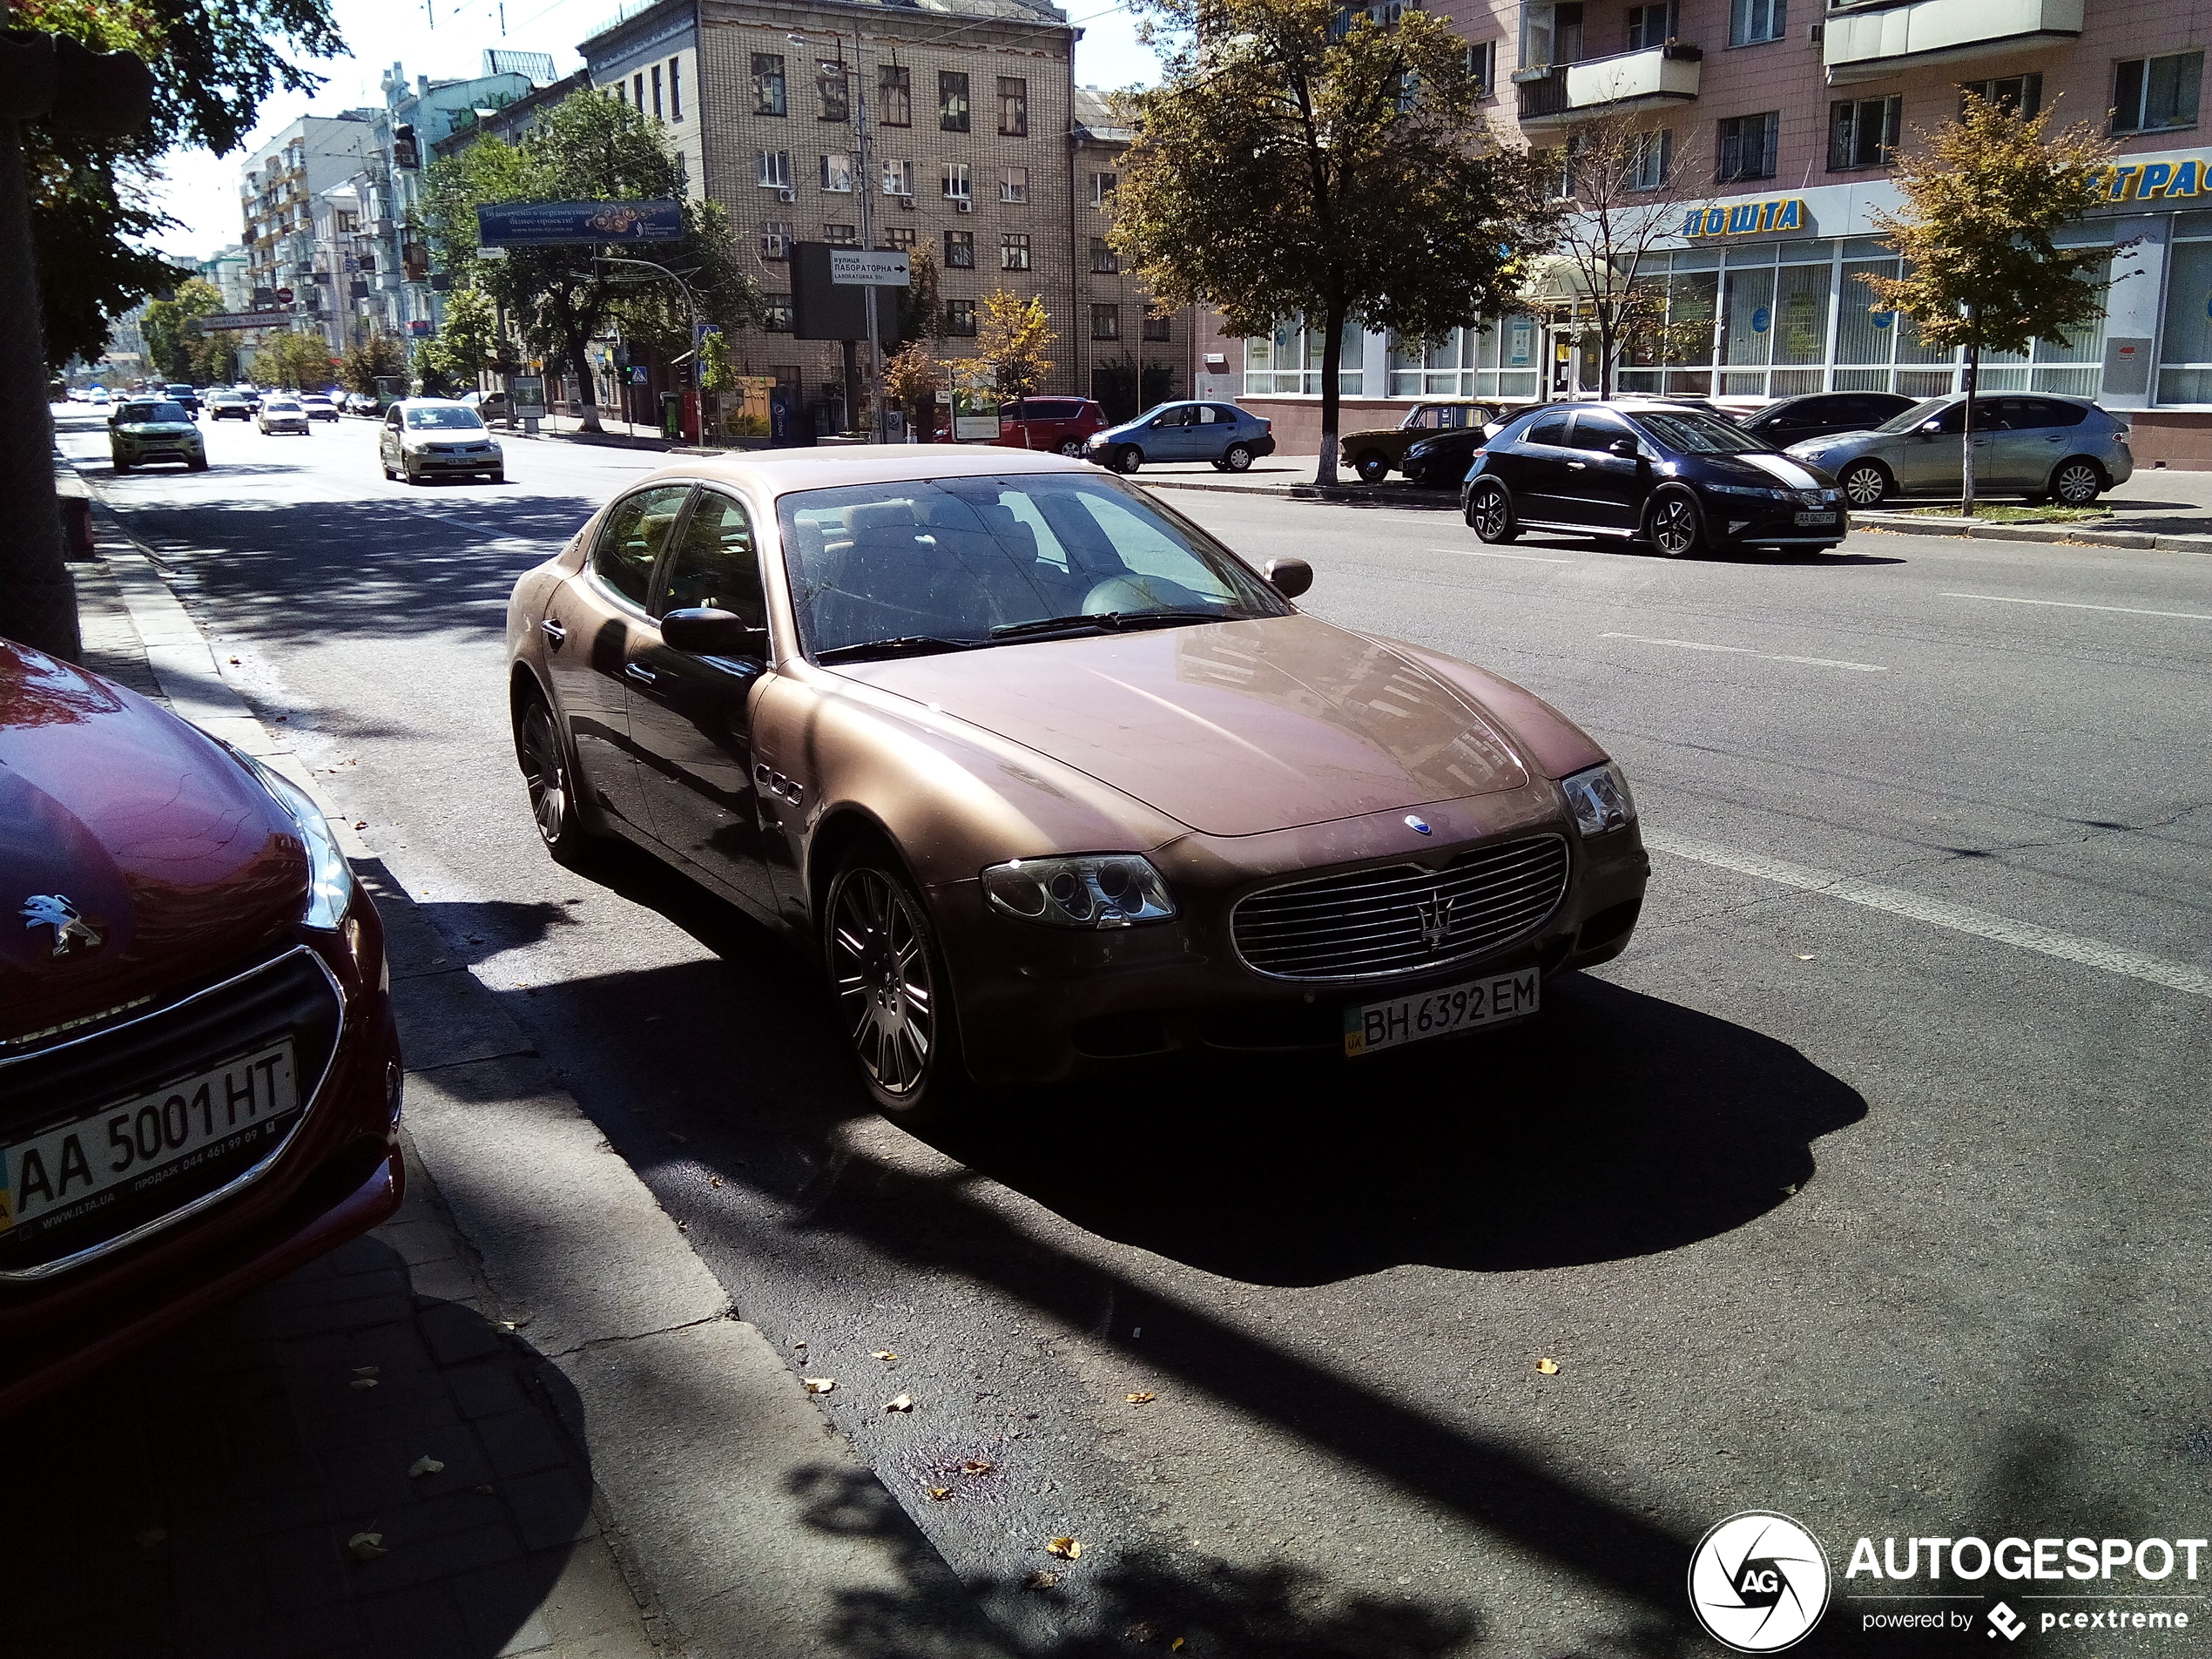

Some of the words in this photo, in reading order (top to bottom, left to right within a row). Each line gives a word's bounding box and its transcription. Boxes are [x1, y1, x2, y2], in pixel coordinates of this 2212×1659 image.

[509, 217, 574, 226] бізнес-проекти!
[1682, 199, 1804, 238] ПОШТА
[1365, 1005, 1409, 1045] BH
[1417, 987, 1486, 1031] 6392
[1493, 976, 1534, 1014] EM
[1347, 1038, 1361, 1049] UA
[17, 1134, 93, 1213] AA
[109, 1083, 213, 1173] 5001
[226, 1055, 283, 1125] HT
[135, 1165, 179, 1190] ПРОДАЖ
[183, 1153, 204, 1170] 044
[207, 1143, 226, 1159] 461
[228, 1136, 241, 1150] 99
[245, 1130, 259, 1143] 09
[42, 1192, 115, 1230] WWW.ILTA.UA
